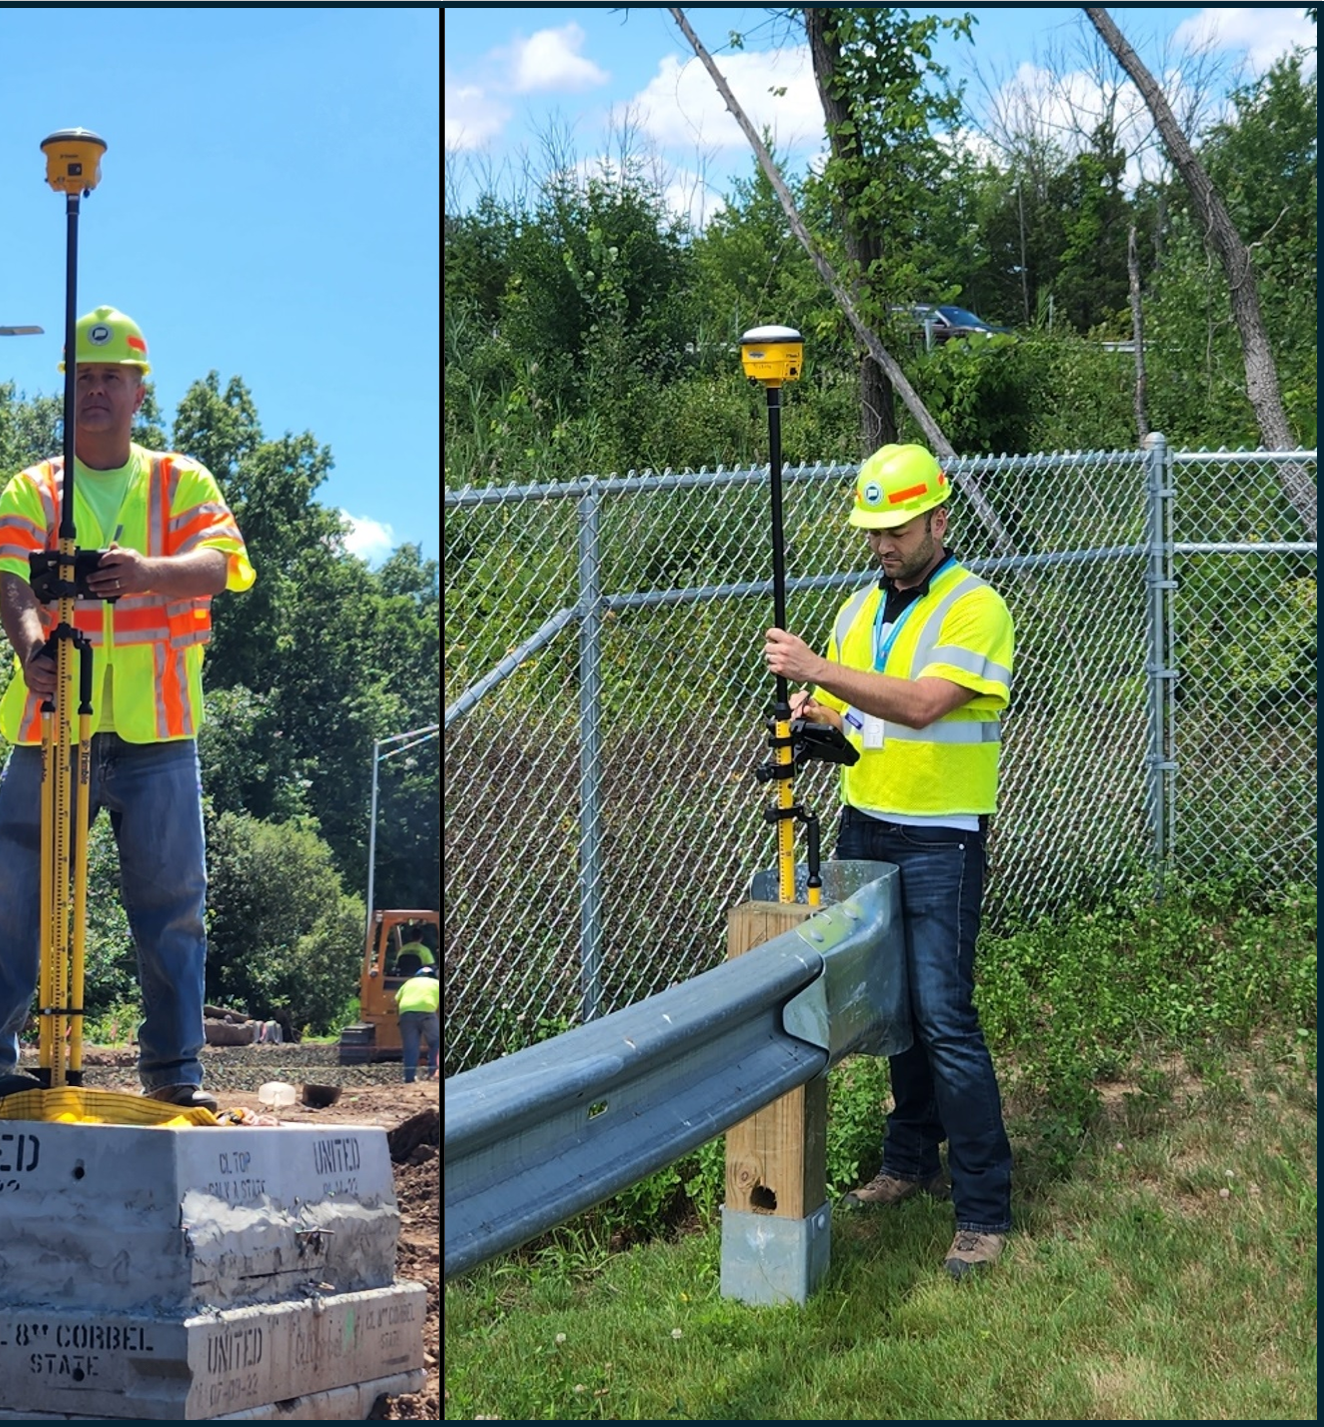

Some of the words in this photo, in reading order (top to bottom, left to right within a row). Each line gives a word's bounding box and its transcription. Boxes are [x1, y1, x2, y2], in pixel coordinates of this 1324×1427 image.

[313, 1137, 361, 1175] UNITED
[56, 1324, 154, 1351] CORBEL
[207, 1327, 263, 1375] UNITED
[29, 1353, 100, 1376] STATE
